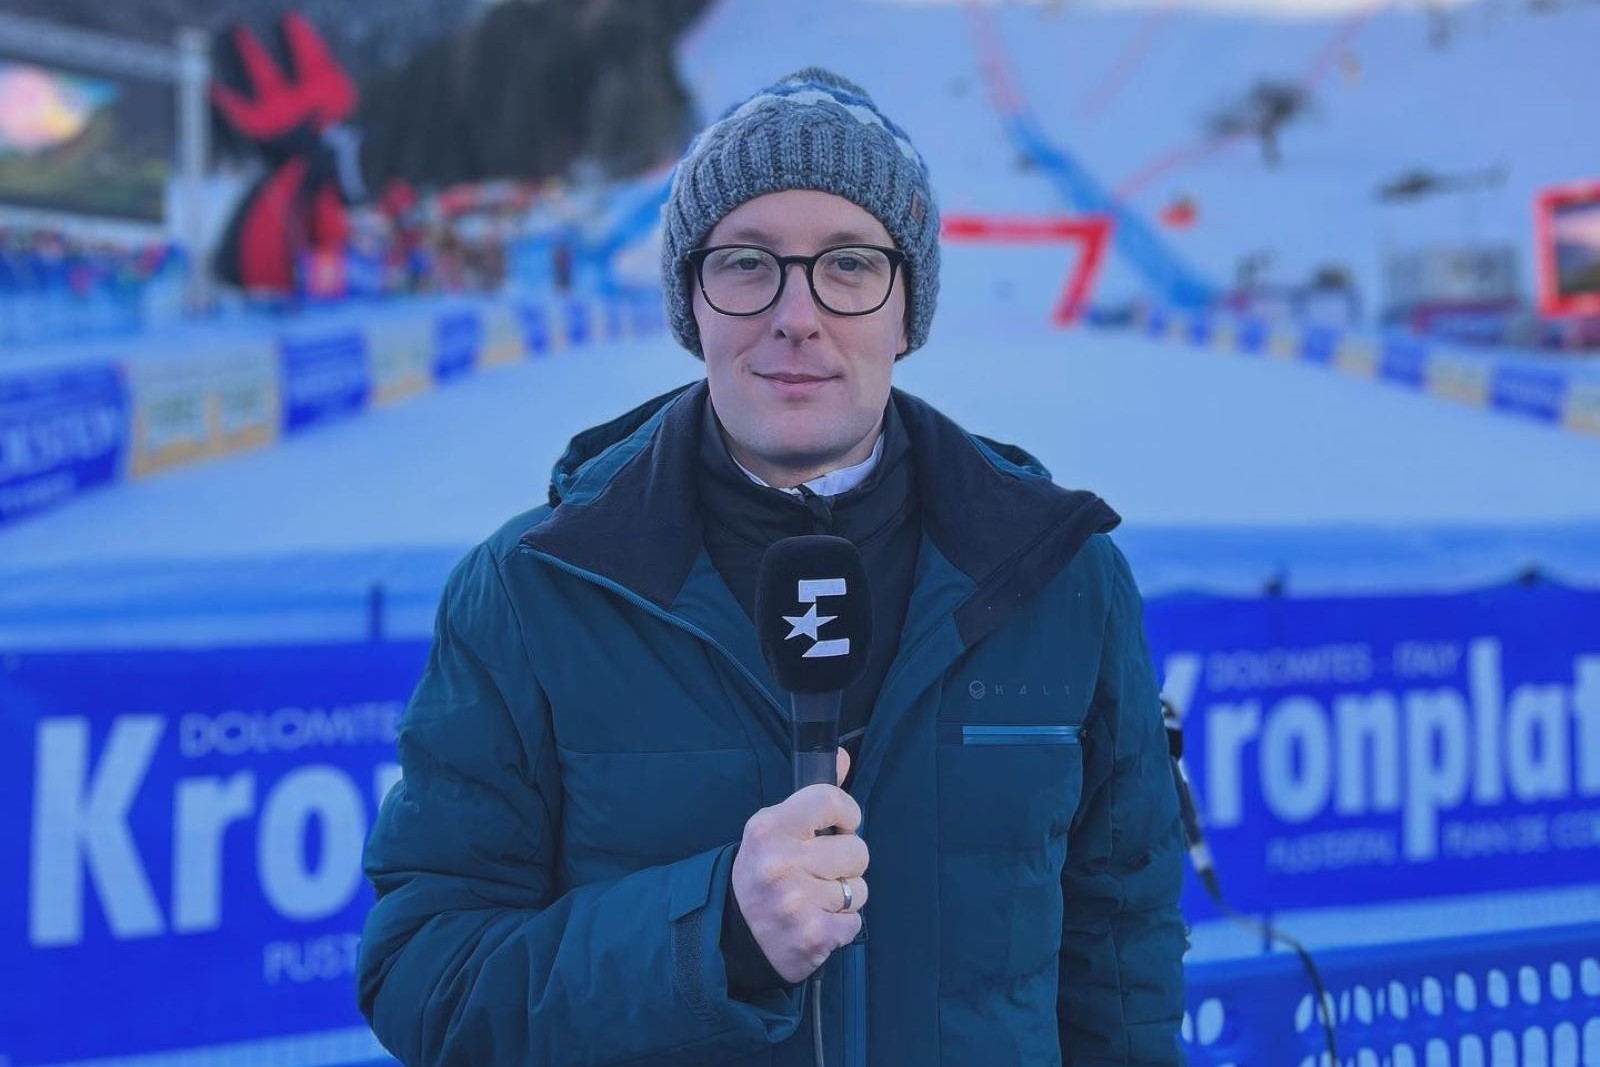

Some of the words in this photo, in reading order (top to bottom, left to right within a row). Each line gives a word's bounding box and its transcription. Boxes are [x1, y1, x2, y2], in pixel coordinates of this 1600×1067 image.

[1205, 643, 1374, 692] DOLOMITES
[1392, 640, 1465, 679] ITALY
[180, 703, 402, 757] DOLOMITE
[1161, 638, 1600, 862] ronplat
[29, 713, 404, 948] Kro
[1551, 810, 1600, 849] CO
[263, 932, 361, 984] PUST
